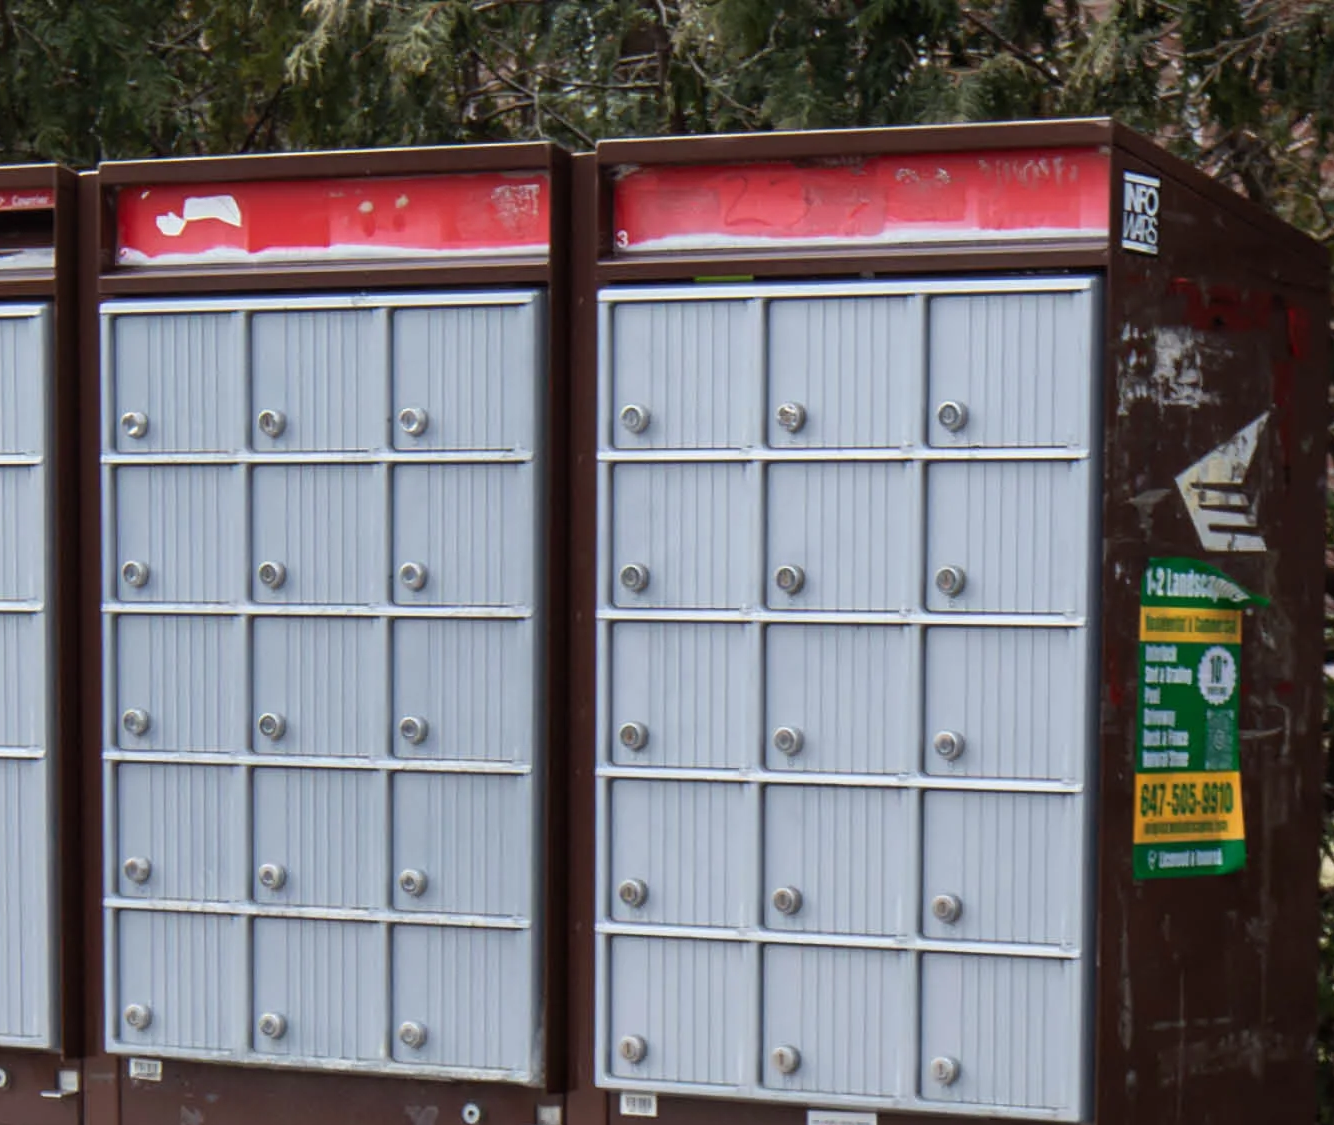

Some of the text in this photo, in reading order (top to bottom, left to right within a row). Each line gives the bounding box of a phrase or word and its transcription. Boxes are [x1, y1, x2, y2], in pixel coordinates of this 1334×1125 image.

[1124, 182, 1159, 217] INFO
[617, 230, 628, 248] 3
[1123, 211, 1159, 245] WARS
